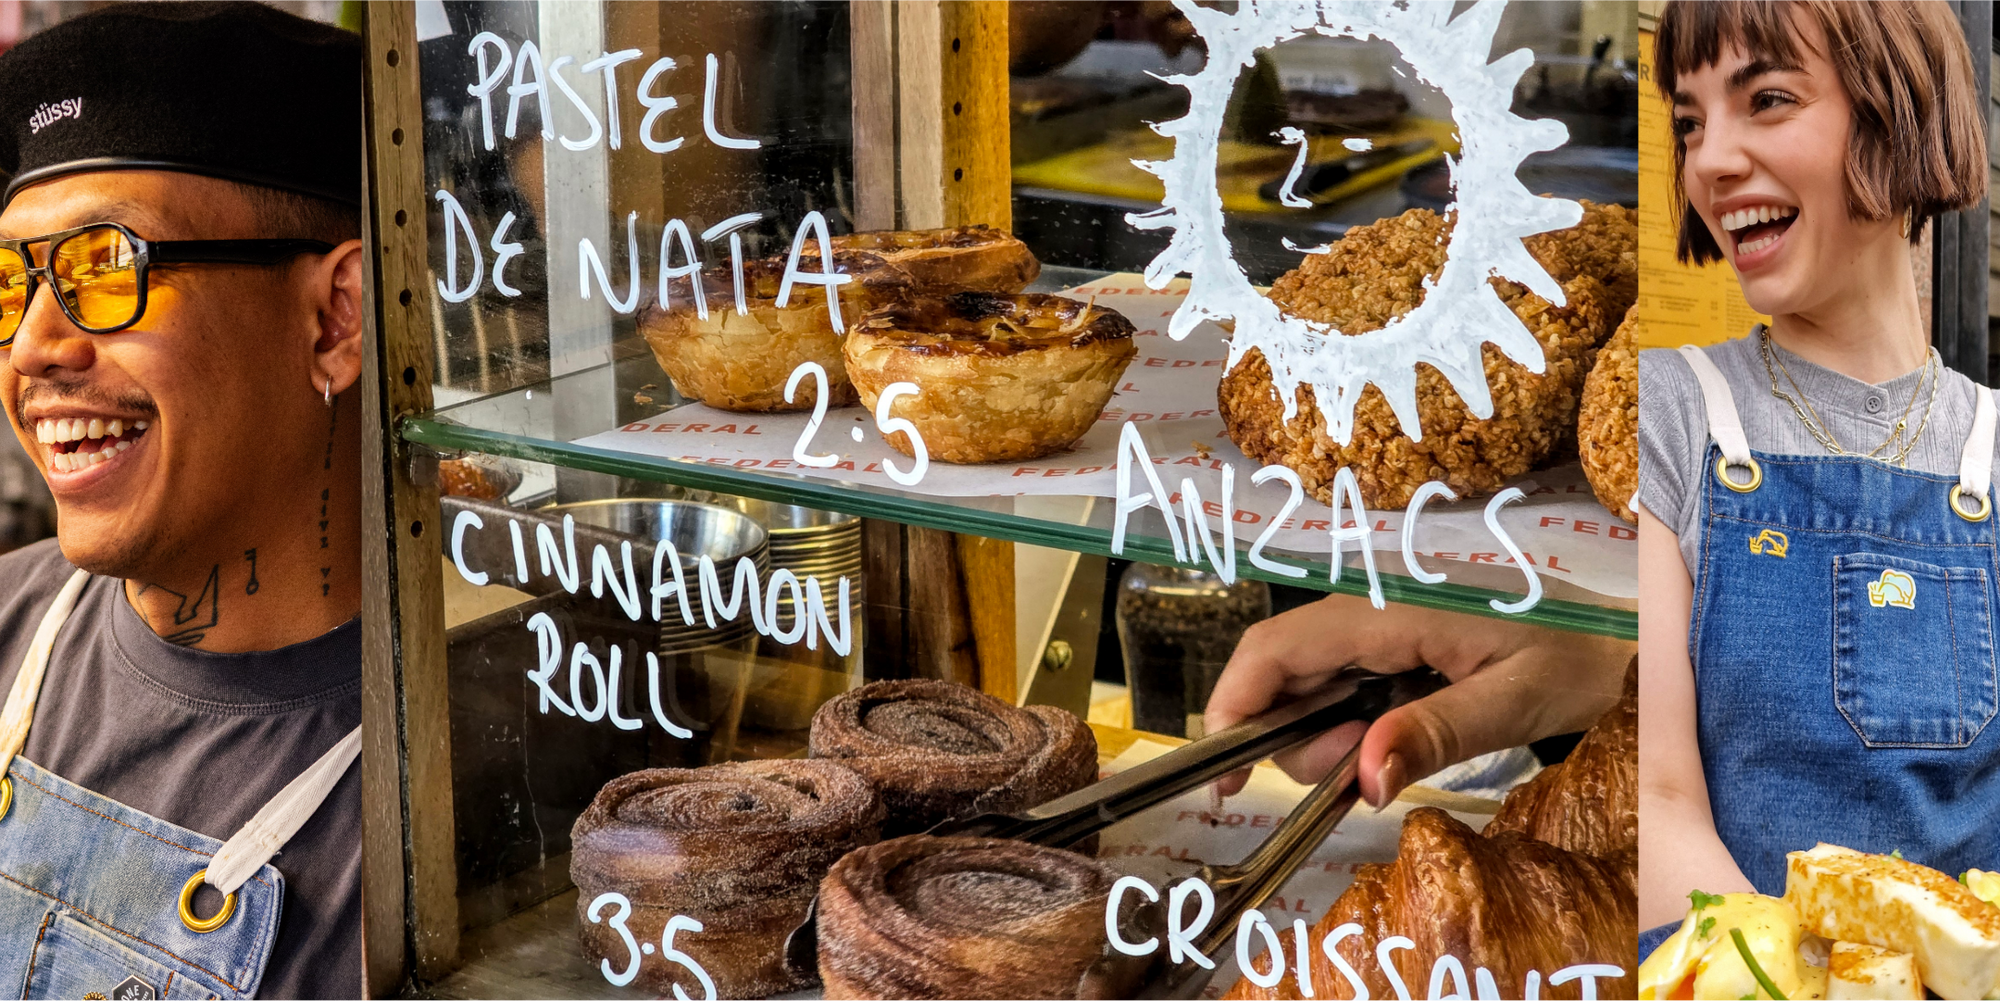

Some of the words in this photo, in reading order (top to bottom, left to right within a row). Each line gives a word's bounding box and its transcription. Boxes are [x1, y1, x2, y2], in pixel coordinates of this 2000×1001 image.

[29, 96, 82, 135] stüssy
[467, 31, 763, 153] PASTEL
[434, 190, 525, 303] DE
[578, 210, 853, 336] NATA
[451, 509, 852, 657] CINNAMON
[1111, 420, 1544, 614] ANZACS
[526, 611, 693, 739] ROLL
